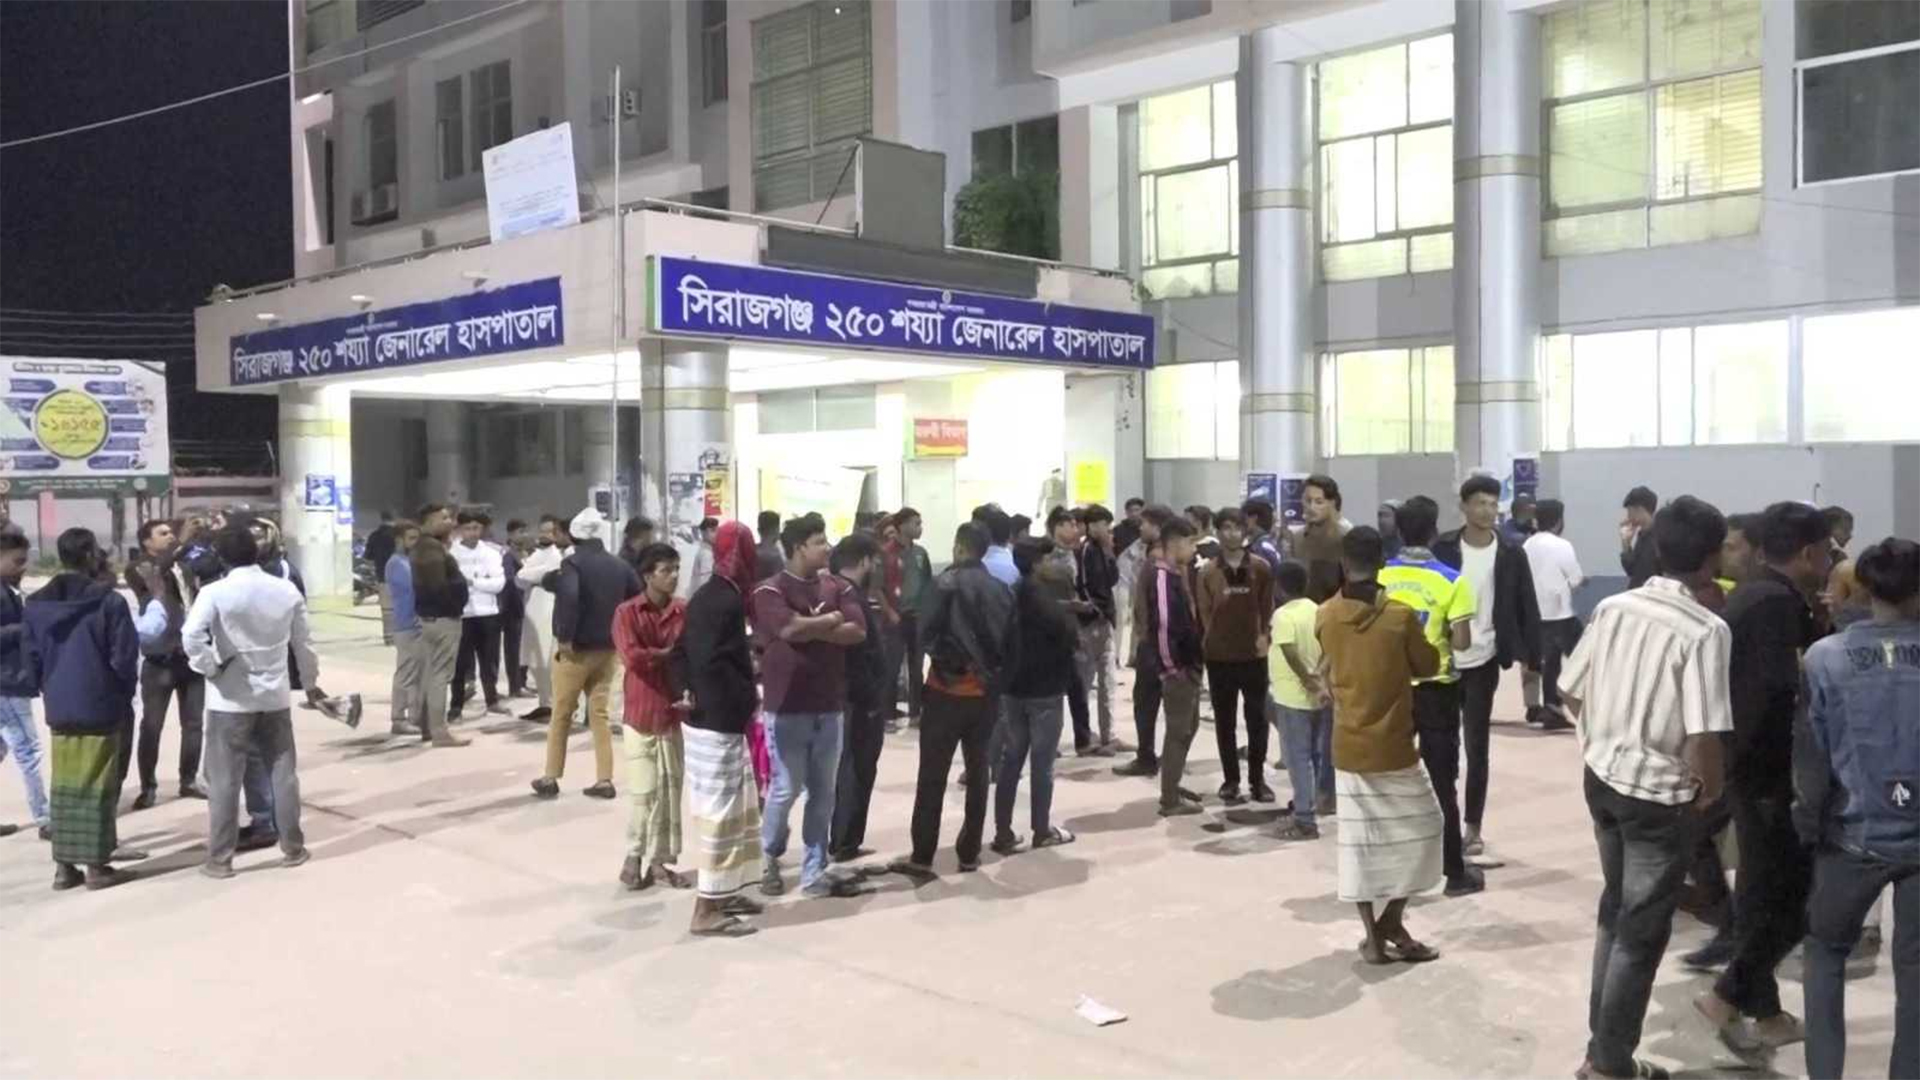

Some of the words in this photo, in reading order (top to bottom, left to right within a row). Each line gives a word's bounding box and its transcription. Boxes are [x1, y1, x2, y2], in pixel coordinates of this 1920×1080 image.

[299, 345, 332, 374] ২৫০
[333, 335, 370, 366] শয্যা
[375, 323, 451, 363] জেনারেল
[454, 305, 557, 351] হাসপাতাল
[677, 274, 814, 334] সিরাজগঞ্জ
[826, 303, 885, 339] ২৫০
[889, 307, 946, 344] শয্যা
[952, 315, 1047, 353] জেনারেল
[1052, 325, 1146, 362] হাসপাতাল
